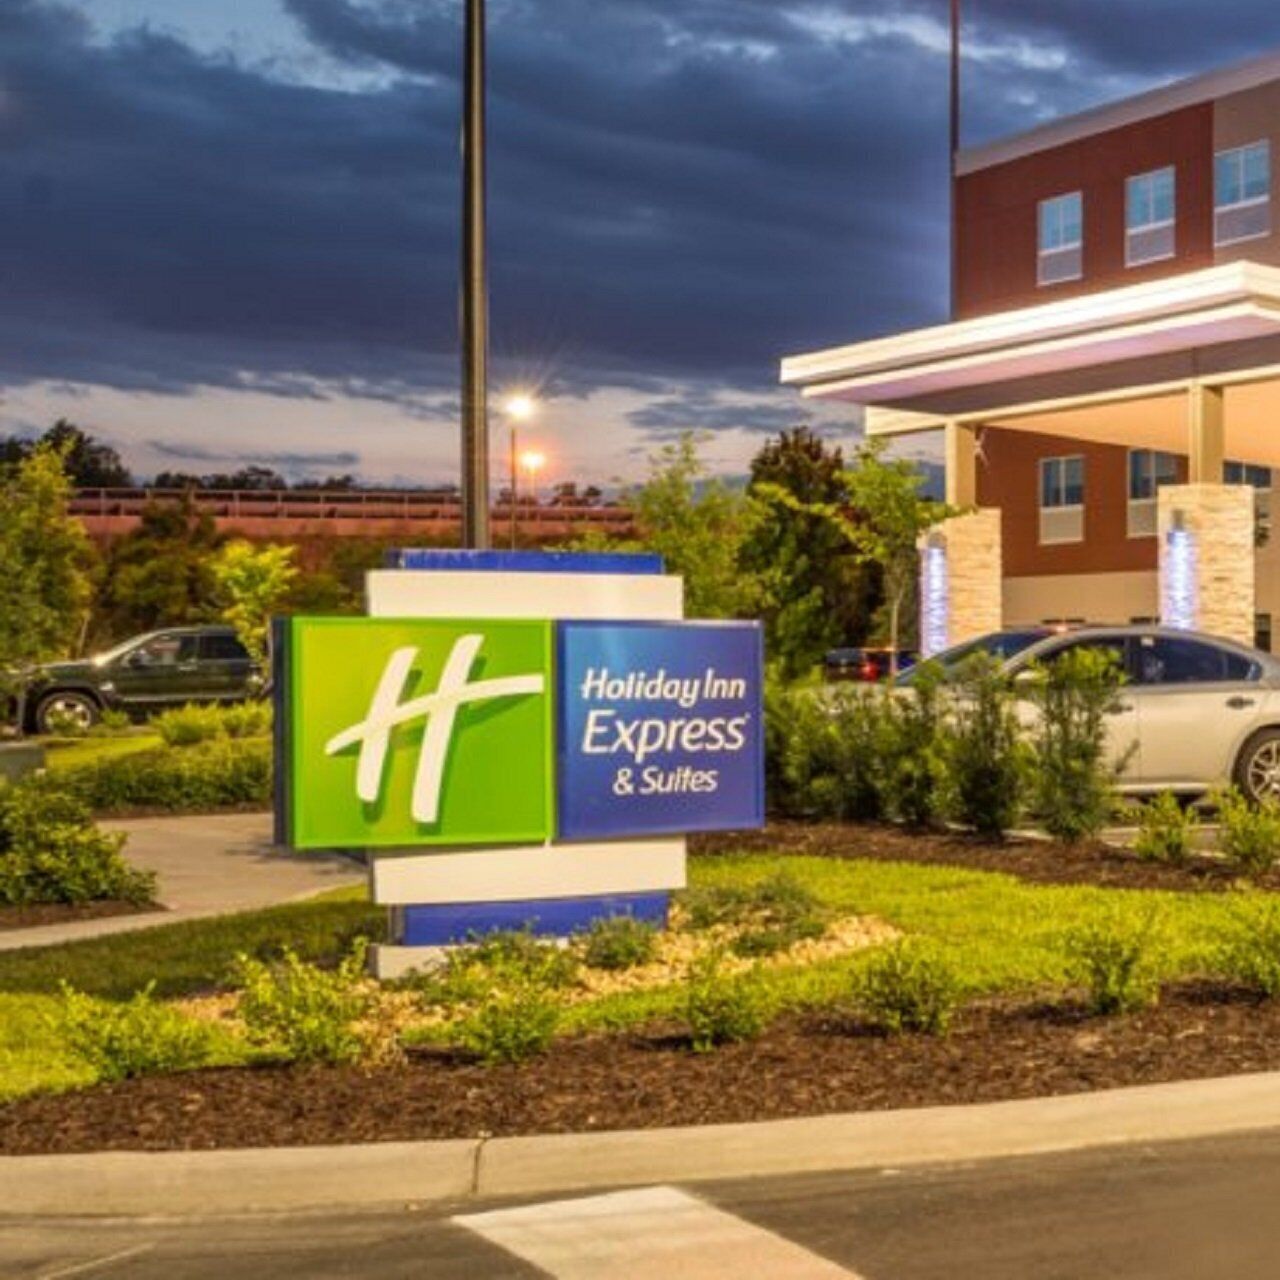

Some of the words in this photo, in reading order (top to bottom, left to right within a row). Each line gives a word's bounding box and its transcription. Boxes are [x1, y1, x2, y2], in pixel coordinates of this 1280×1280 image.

[581, 667, 700, 708] Holiday
[703, 667, 747, 699] Inn
[582, 708, 747, 764] Express
[612, 767, 635, 796] &
[639, 765, 719, 795] Suites
